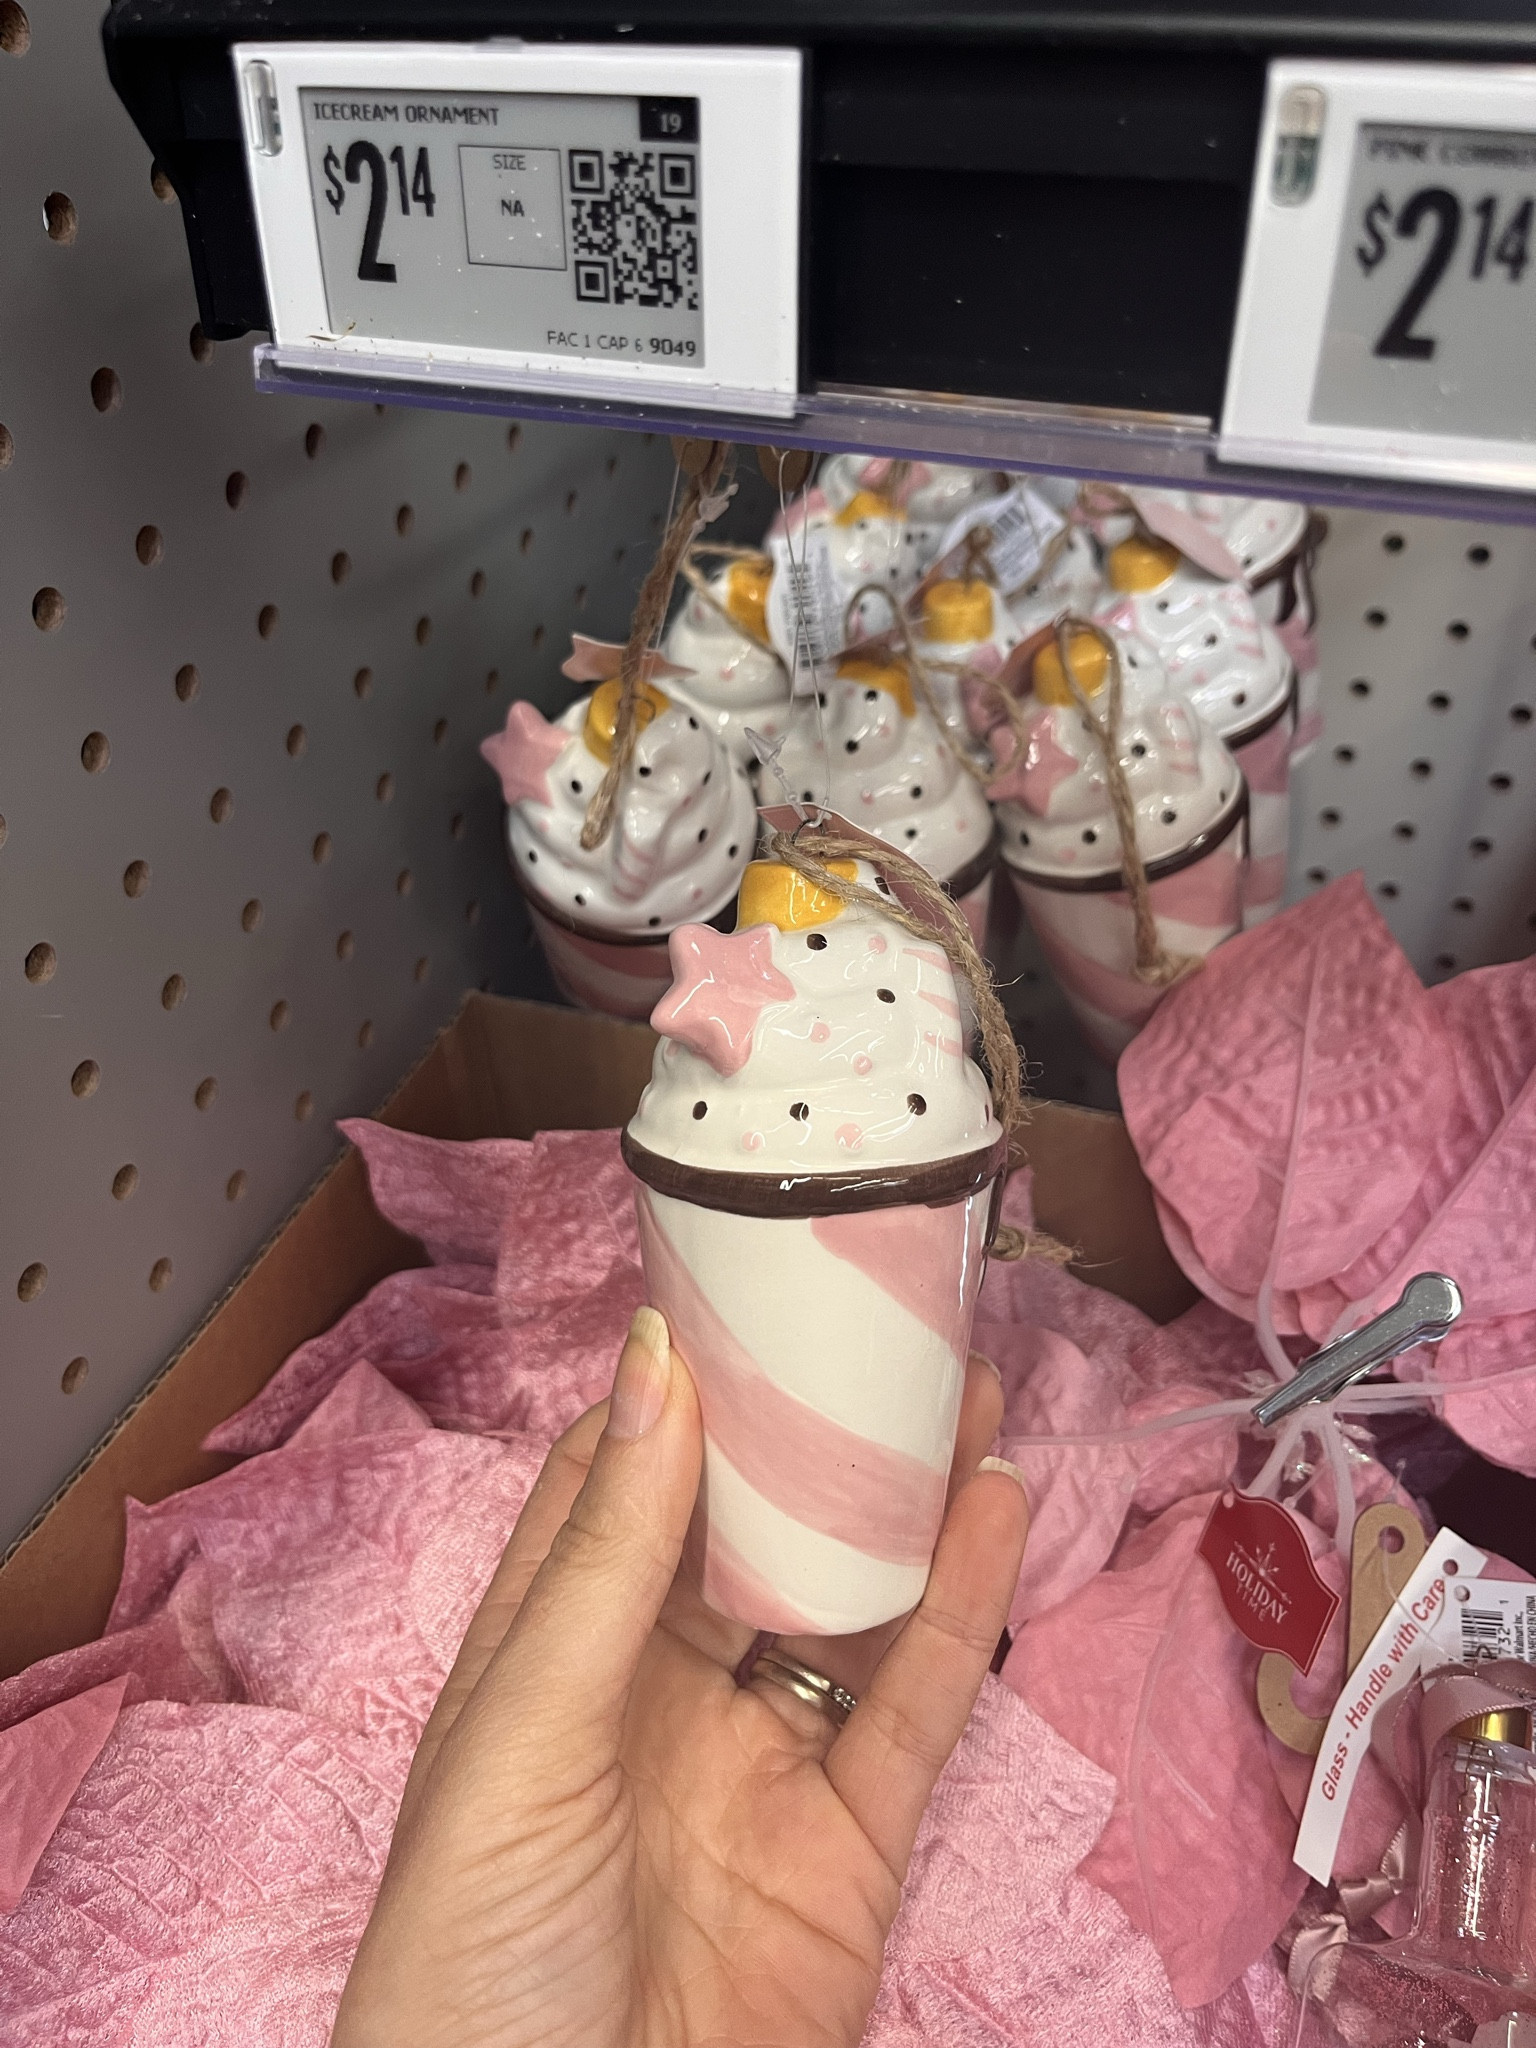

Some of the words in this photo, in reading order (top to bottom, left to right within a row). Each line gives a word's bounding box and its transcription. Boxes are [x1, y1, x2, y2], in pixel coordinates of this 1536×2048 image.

[313, 102, 399, 122] ICECREAM
[405, 104, 499, 126] ORNAMENT
[660, 112, 682, 134] 19
[493, 154, 526, 171] SIZE
[501, 199, 525, 217] NA
[547, 330, 578, 347] FAC
[584, 334, 591, 348] 1
[597, 335, 628, 351] CAP
[635, 338, 643, 353] 6
[650, 337, 696, 357] 9049
[1226, 1551, 1288, 1623] HOLIDAY
[1235, 1580, 1267, 1622] TIME
[1497, 1626, 1511, 1655] 732
[1513, 1626, 1525, 1654] Walmart
[1321, 1742, 1348, 1801] Glass
[1345, 1664, 1393, 1730] Handle
[1388, 1620, 1419, 1663] with
[1411, 1578, 1445, 1622] Care
